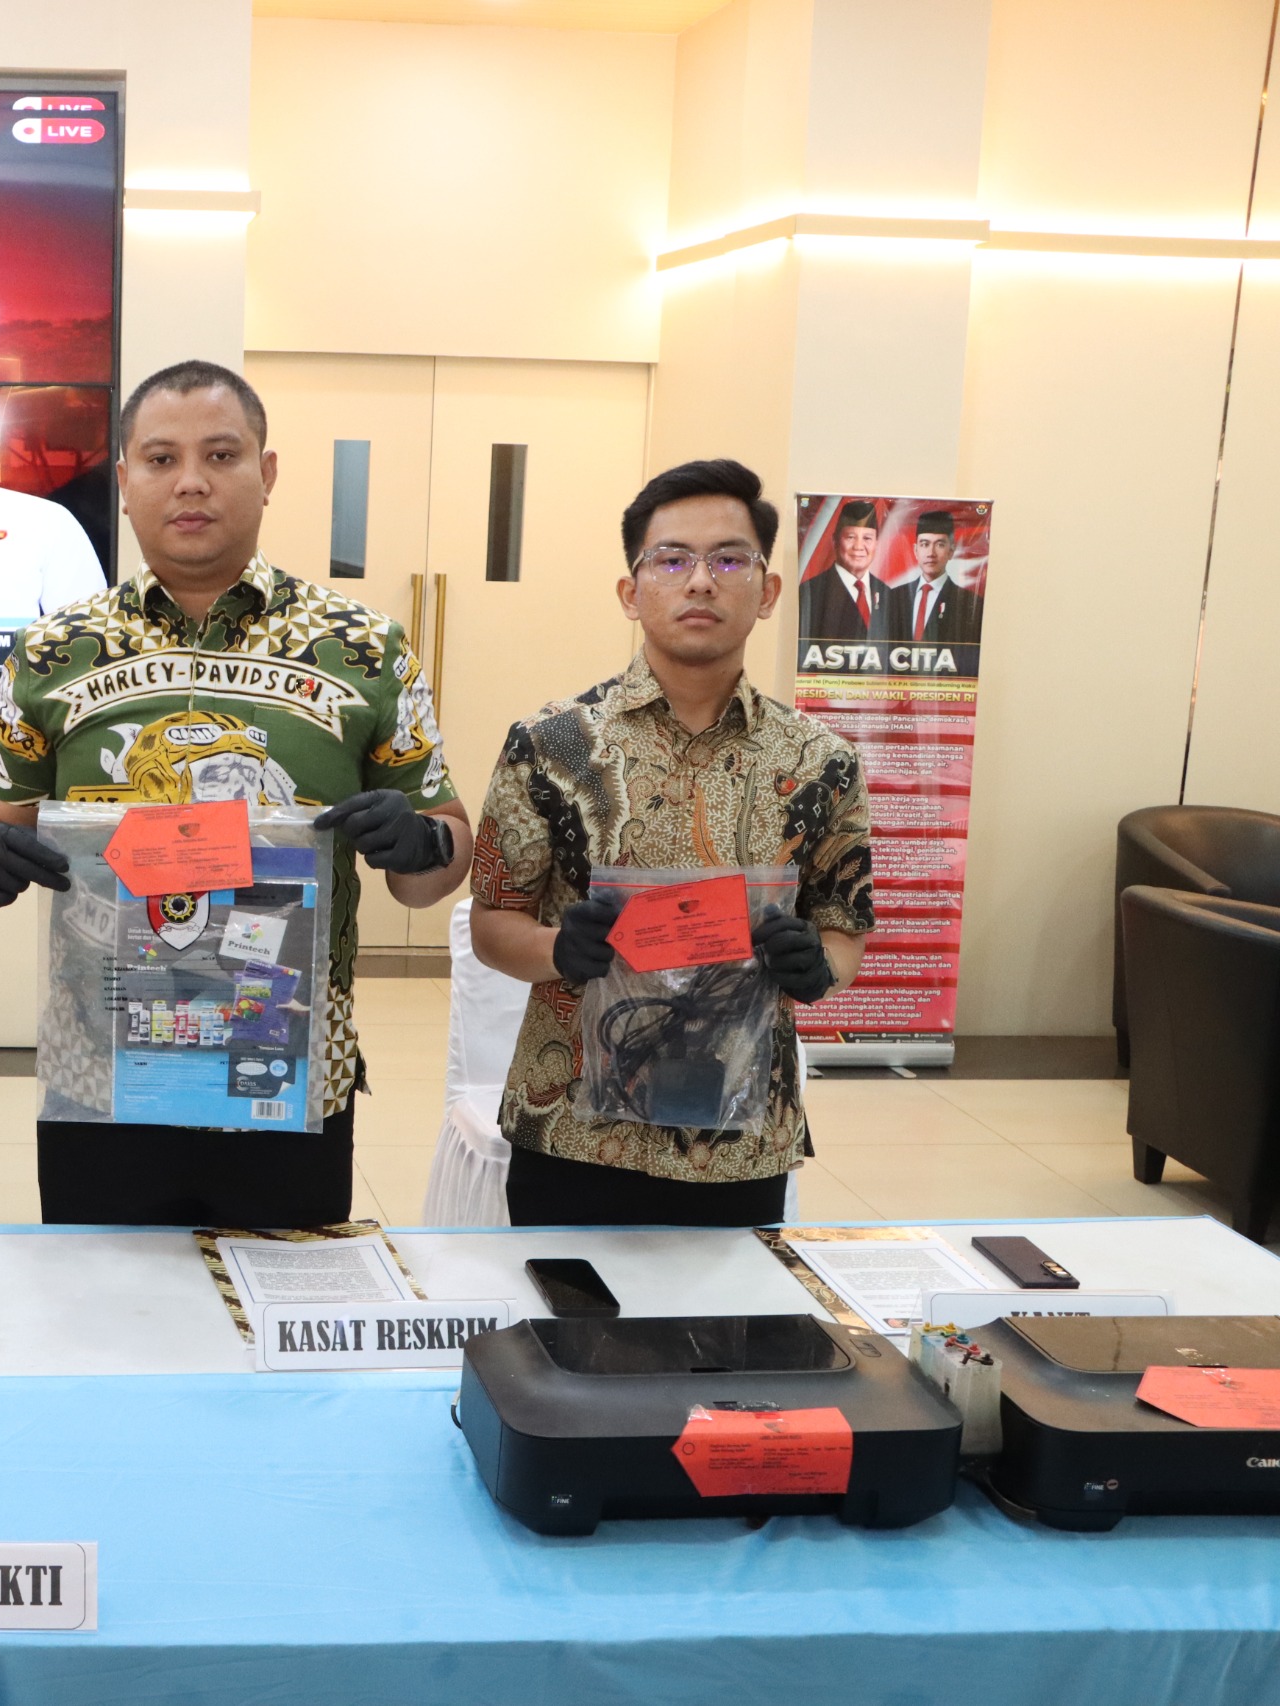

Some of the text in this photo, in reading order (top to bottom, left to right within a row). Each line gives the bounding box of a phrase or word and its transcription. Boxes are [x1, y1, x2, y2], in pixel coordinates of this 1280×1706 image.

[47, 126, 93, 137] LIVE
[802, 644, 958, 673] ASTA CITA
[846, 690, 870, 700] DAN
[871, 690, 907, 701] WAKIL
[909, 691, 961, 702] PRESIDEN
[963, 693, 975, 702] RI
[864, 715, 891, 723] ideologi
[929, 716, 970, 725] demokrasi,
[890, 723, 914, 731] (HAM)
[885, 744, 927, 753] pertahanan
[892, 752, 936, 760] kemandirian
[936, 753, 964, 762] bangsa
[882, 760, 912, 769] pangan,
[913, 761, 936, 769] energi,
[898, 768, 920, 776] hijau,
[891, 796, 910, 804] kerja
[906, 819, 953, 827] infrastruktur.
[929, 839, 945, 847] daya
[879, 847, 957, 856] teknologi, pendidikan,
[872, 855, 904, 864] olahraga,
[888, 864, 952, 872] peran perempuan,
[892, 871, 931, 879] disabilitas.
[889, 891, 938, 899] industrialisasi
[927, 900, 952, 908] negeri.
[227, 940, 271, 956] Printech
[875, 954, 900, 962] politik,
[893, 962, 938, 971] pencegahan
[885, 988, 923, 997] kehidupan
[924, 989, 942, 998] yang
[853, 996, 896, 1004] lingkungan,
[838, 1004, 884, 1012] peningkatan
[828, 1011, 864, 1020] beragama
[887, 1011, 922, 1020] mencapai
[831, 1019, 849, 1027] yang
[277, 1319, 366, 1353] KASAT
